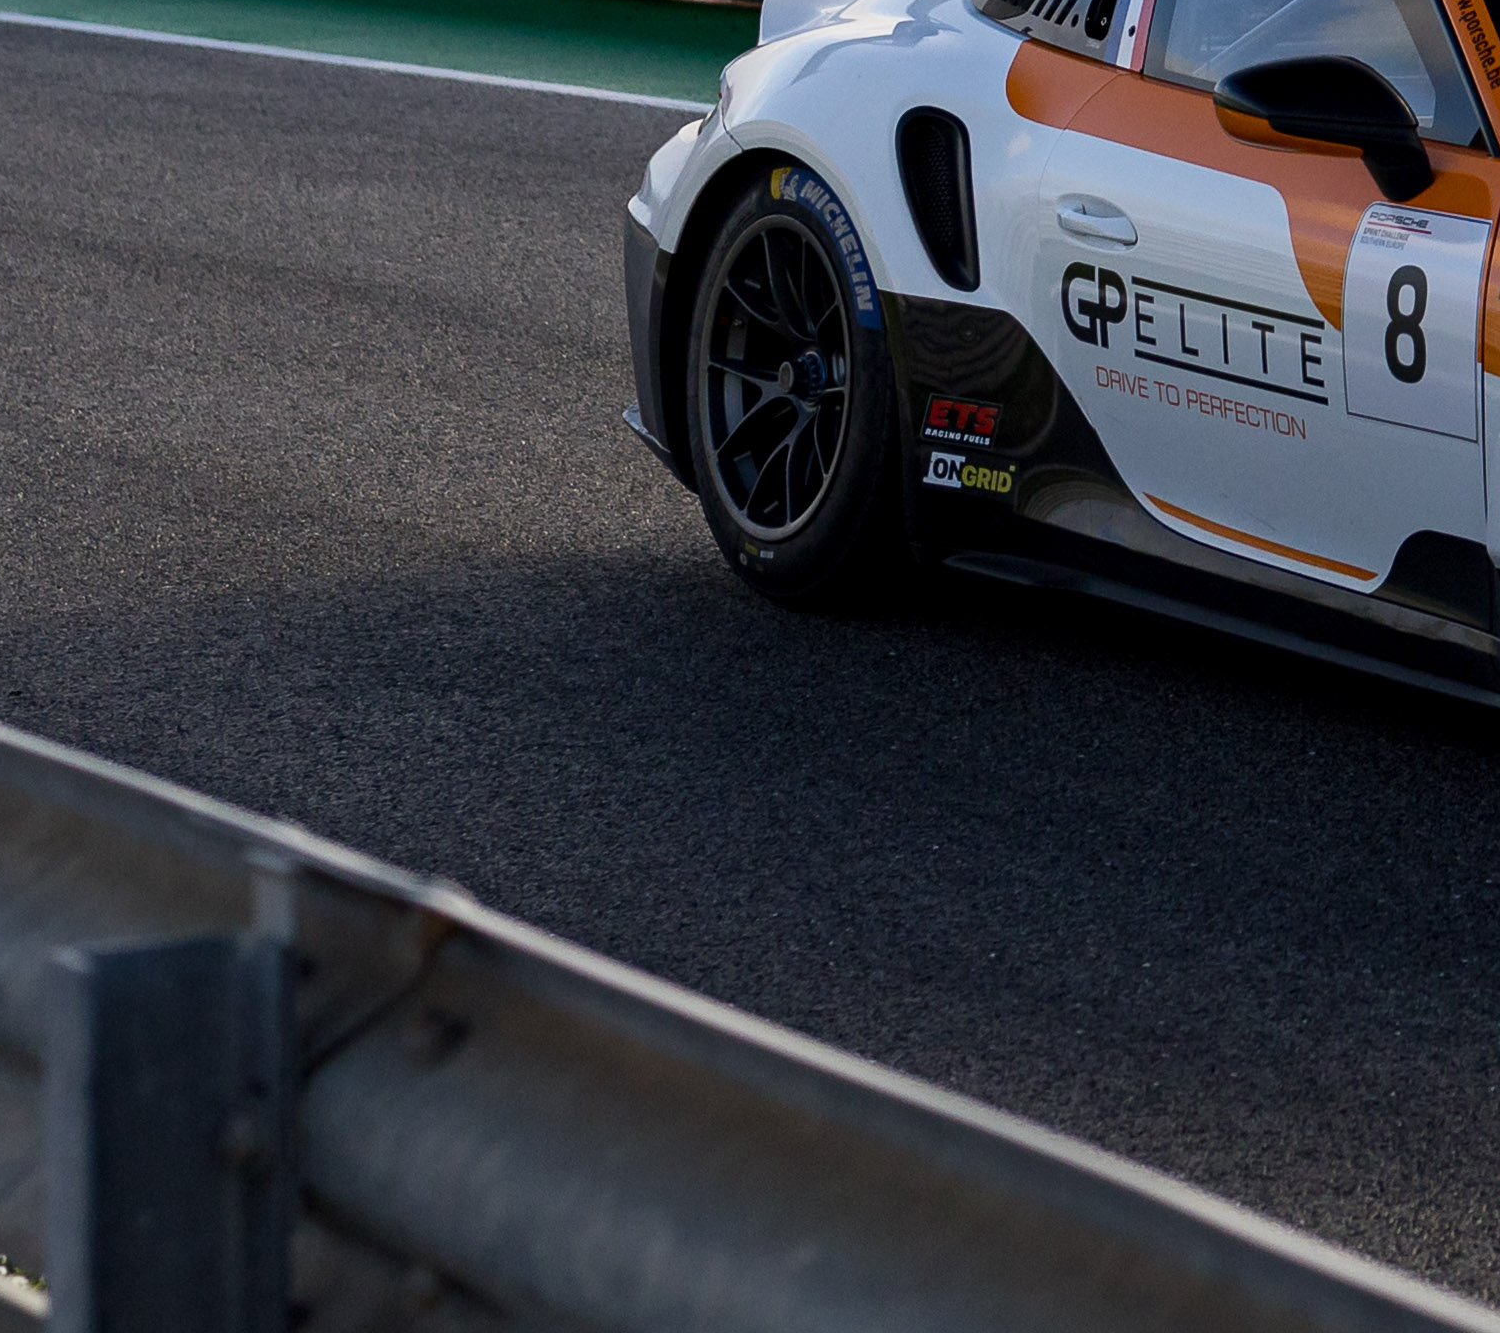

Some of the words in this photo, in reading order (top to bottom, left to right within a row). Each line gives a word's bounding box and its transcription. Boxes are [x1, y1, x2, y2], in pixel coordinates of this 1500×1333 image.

[799, 179, 874, 311] MICHELIN
[1369, 211, 1429, 229] PORSCHE
[1384, 264, 1428, 384] 8
[930, 399, 998, 435] ETS
[1095, 365, 1150, 399] DRIVE
[1153, 380, 1181, 406] TO
[1186, 388, 1307, 440] PERFECTION
[924, 427, 961, 441] RACING
[963, 434, 991, 446] FUELS
